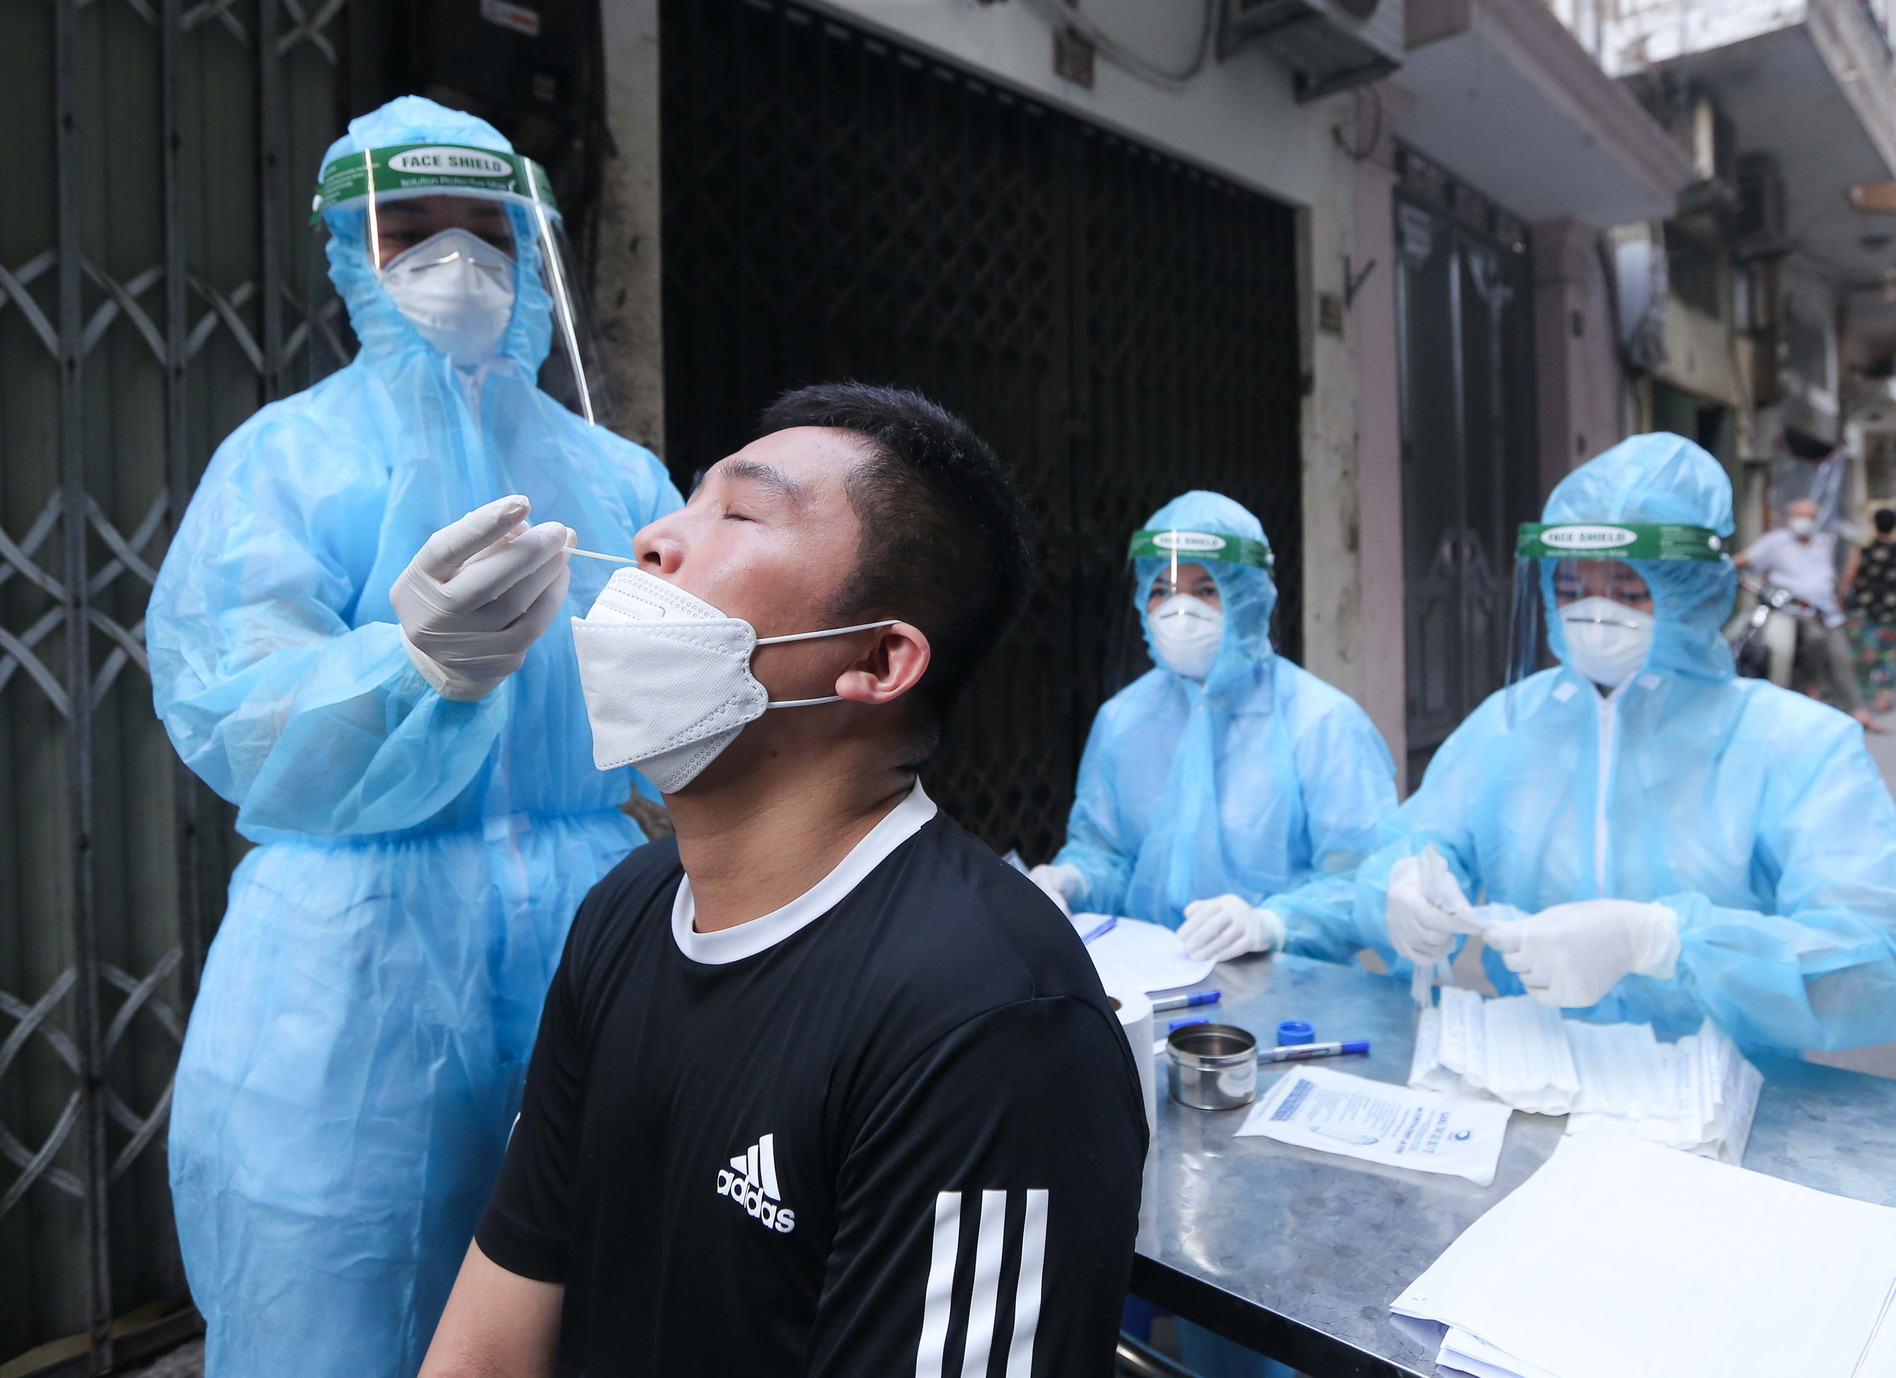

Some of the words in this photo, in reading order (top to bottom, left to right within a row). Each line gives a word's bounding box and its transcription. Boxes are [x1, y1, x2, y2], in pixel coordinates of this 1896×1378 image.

[401, 155, 441, 168] FACE
[448, 155, 502, 172] SHIELD
[716, 1169, 795, 1233] adidas
